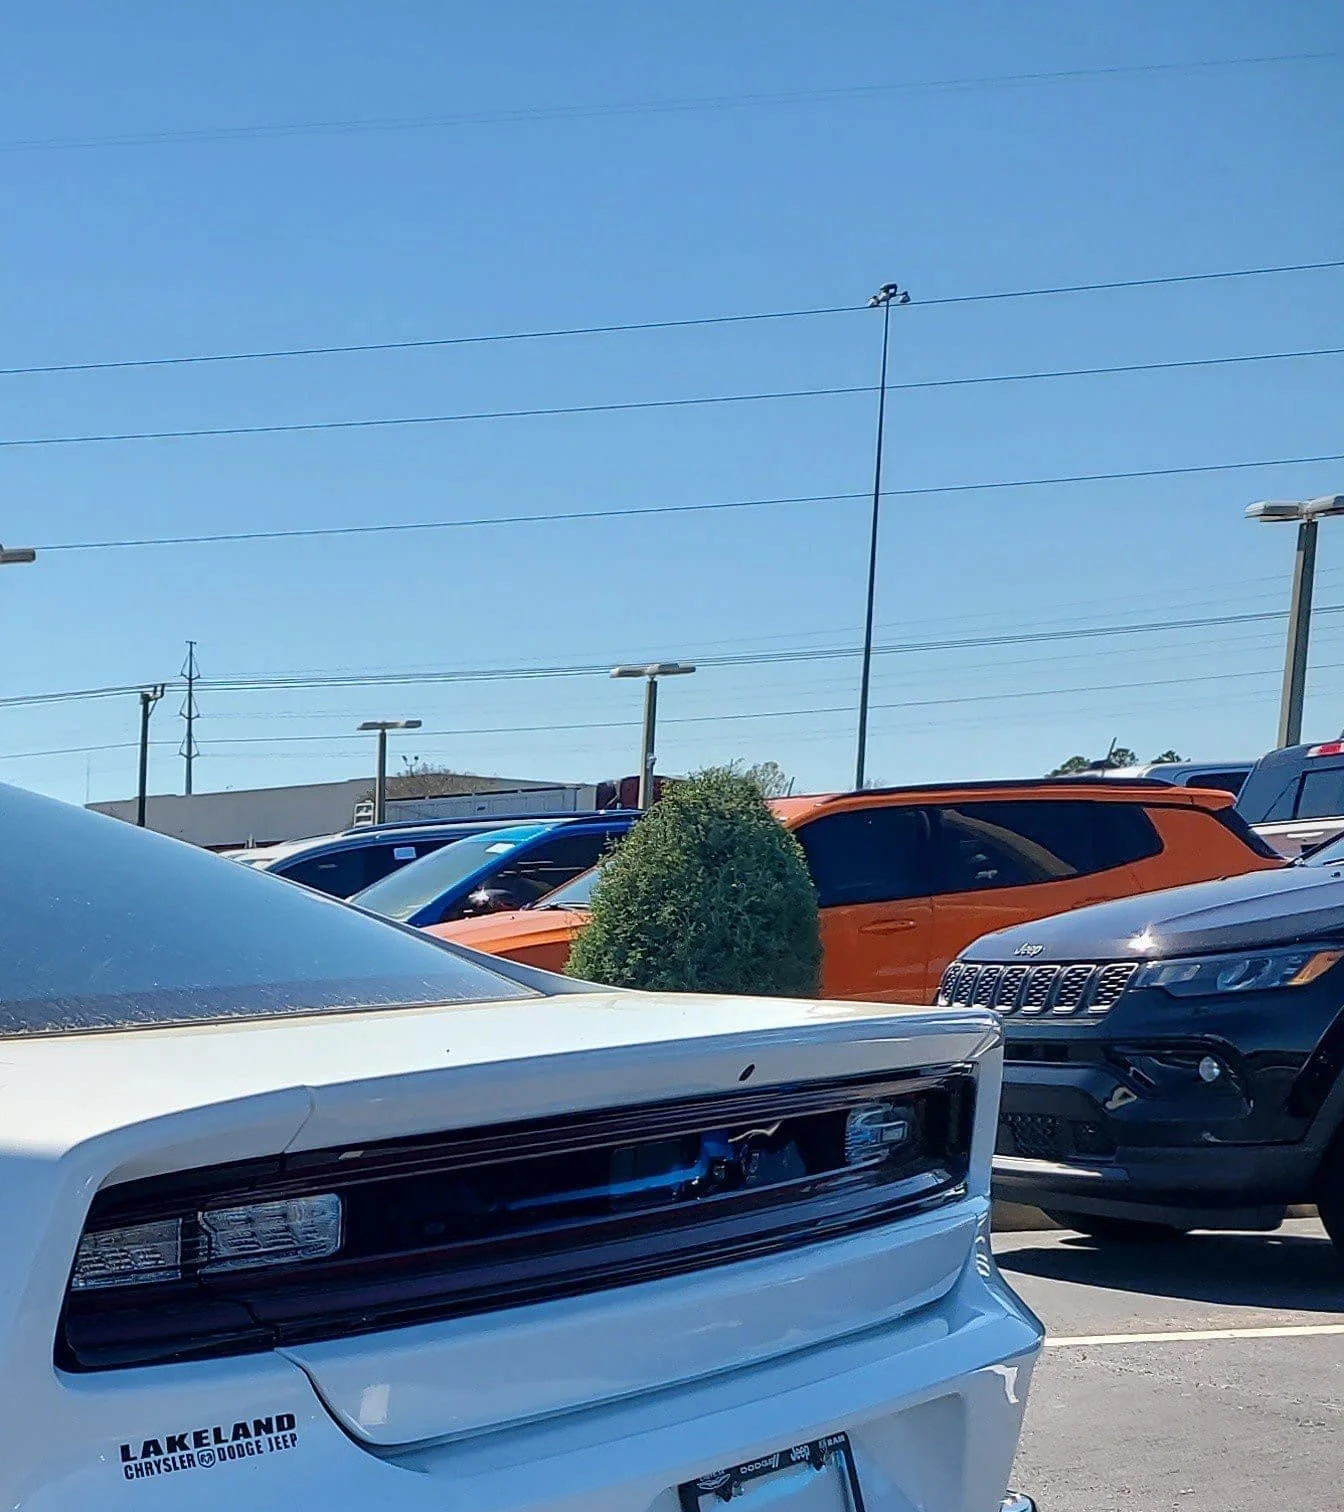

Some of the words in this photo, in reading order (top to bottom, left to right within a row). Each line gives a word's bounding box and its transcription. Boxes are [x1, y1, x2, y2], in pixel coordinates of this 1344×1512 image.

[1013, 942, 1044, 958] Jeep
[120, 1412, 296, 1463] LAKELAND
[123, 1452, 197, 1481] CHRYSLER
[217, 1440, 263, 1462] DODGE
[268, 1431, 298, 1453] JEEP
[790, 1444, 811, 1461] Jeep
[827, 1434, 846, 1447] RAM
